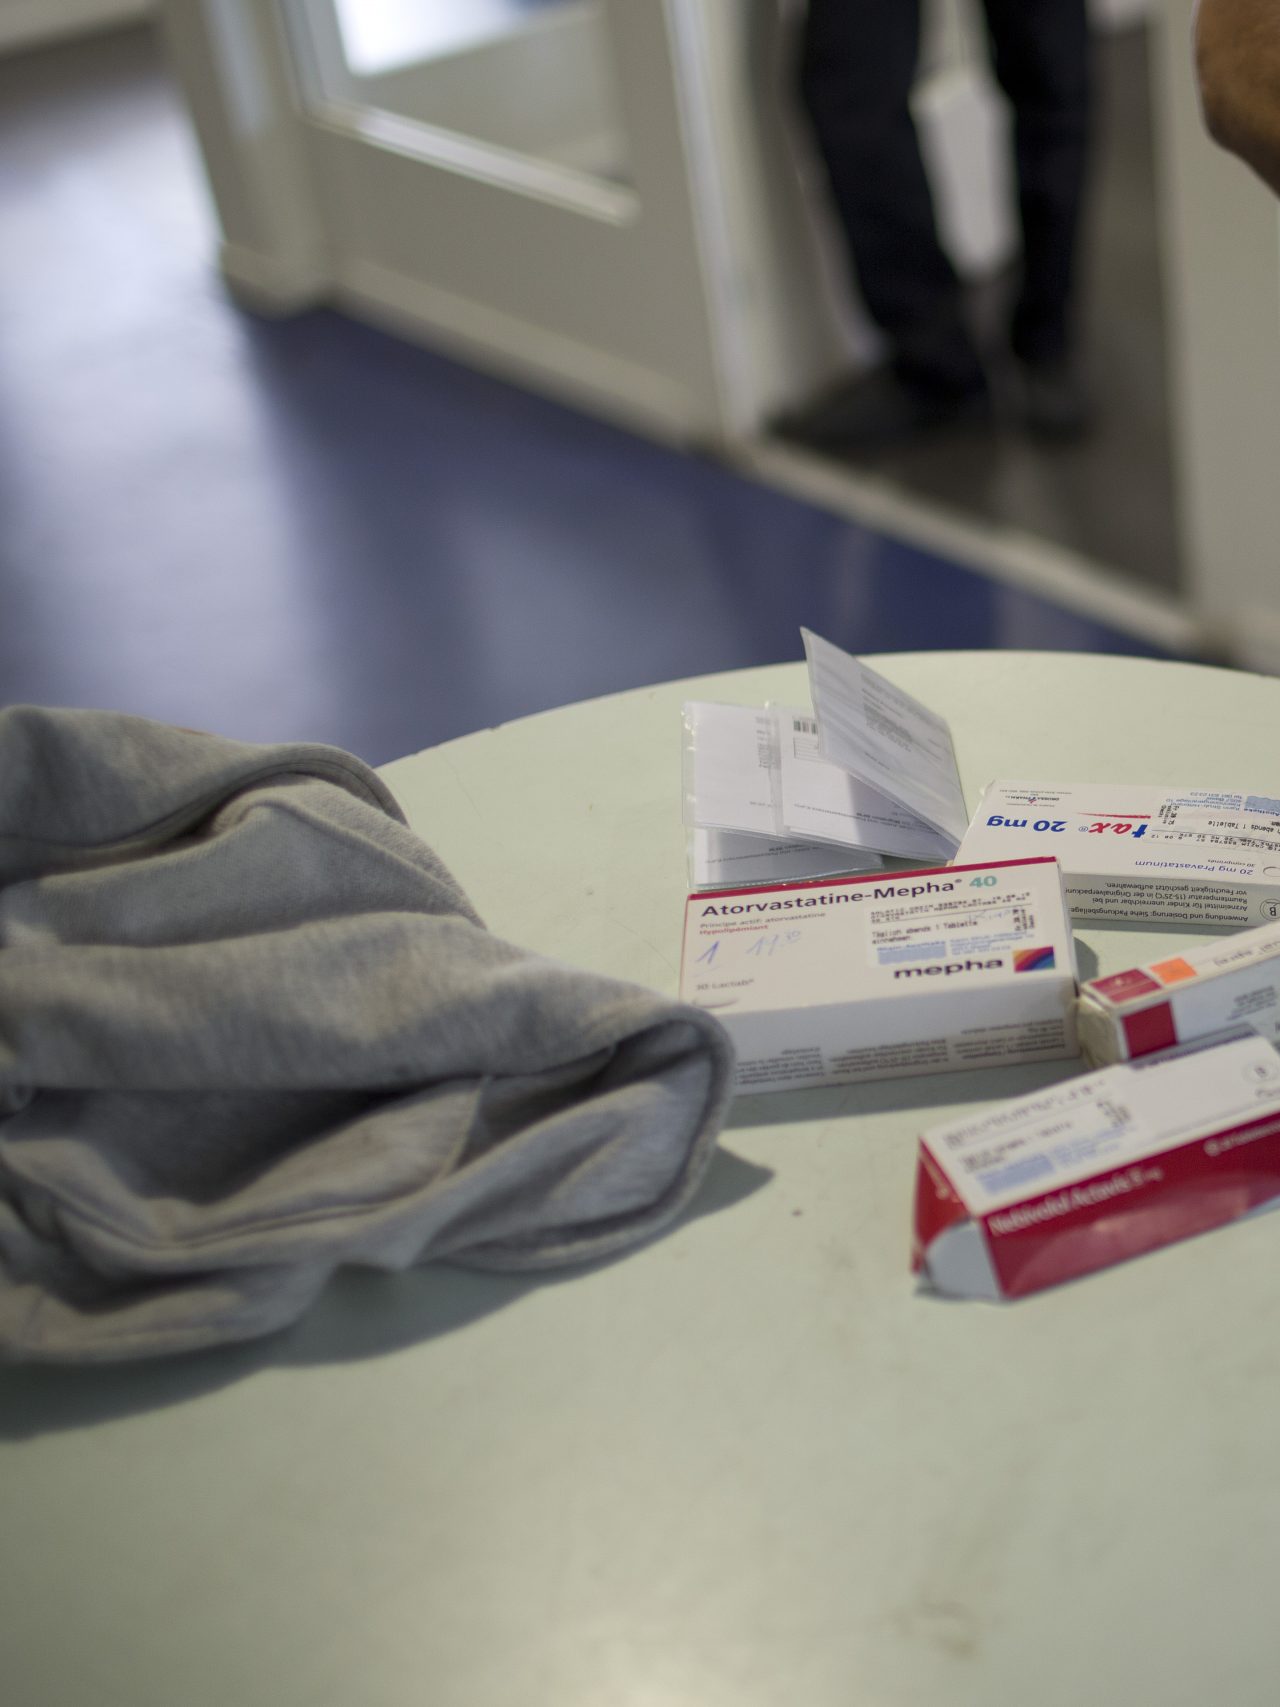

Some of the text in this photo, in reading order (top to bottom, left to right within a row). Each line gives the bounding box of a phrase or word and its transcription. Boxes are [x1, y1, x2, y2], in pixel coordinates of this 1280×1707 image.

[986, 815, 1028, 828] mg
[1033, 820, 1068, 832] 20
[1251, 824, 1274, 833] abends
[1135, 861, 1215, 872] Pravastatinum
[969, 876, 997, 888] 40
[1191, 886, 1234, 895] Feuchtigkeit
[1188, 894, 1247, 904] Raumtemperatur
[1204, 904, 1247, 912] Arzneimittel
[1150, 911, 1187, 919] Dosierung:
[1205, 913, 1248, 922] Anwendung
[894, 960, 1003, 979] mepha
